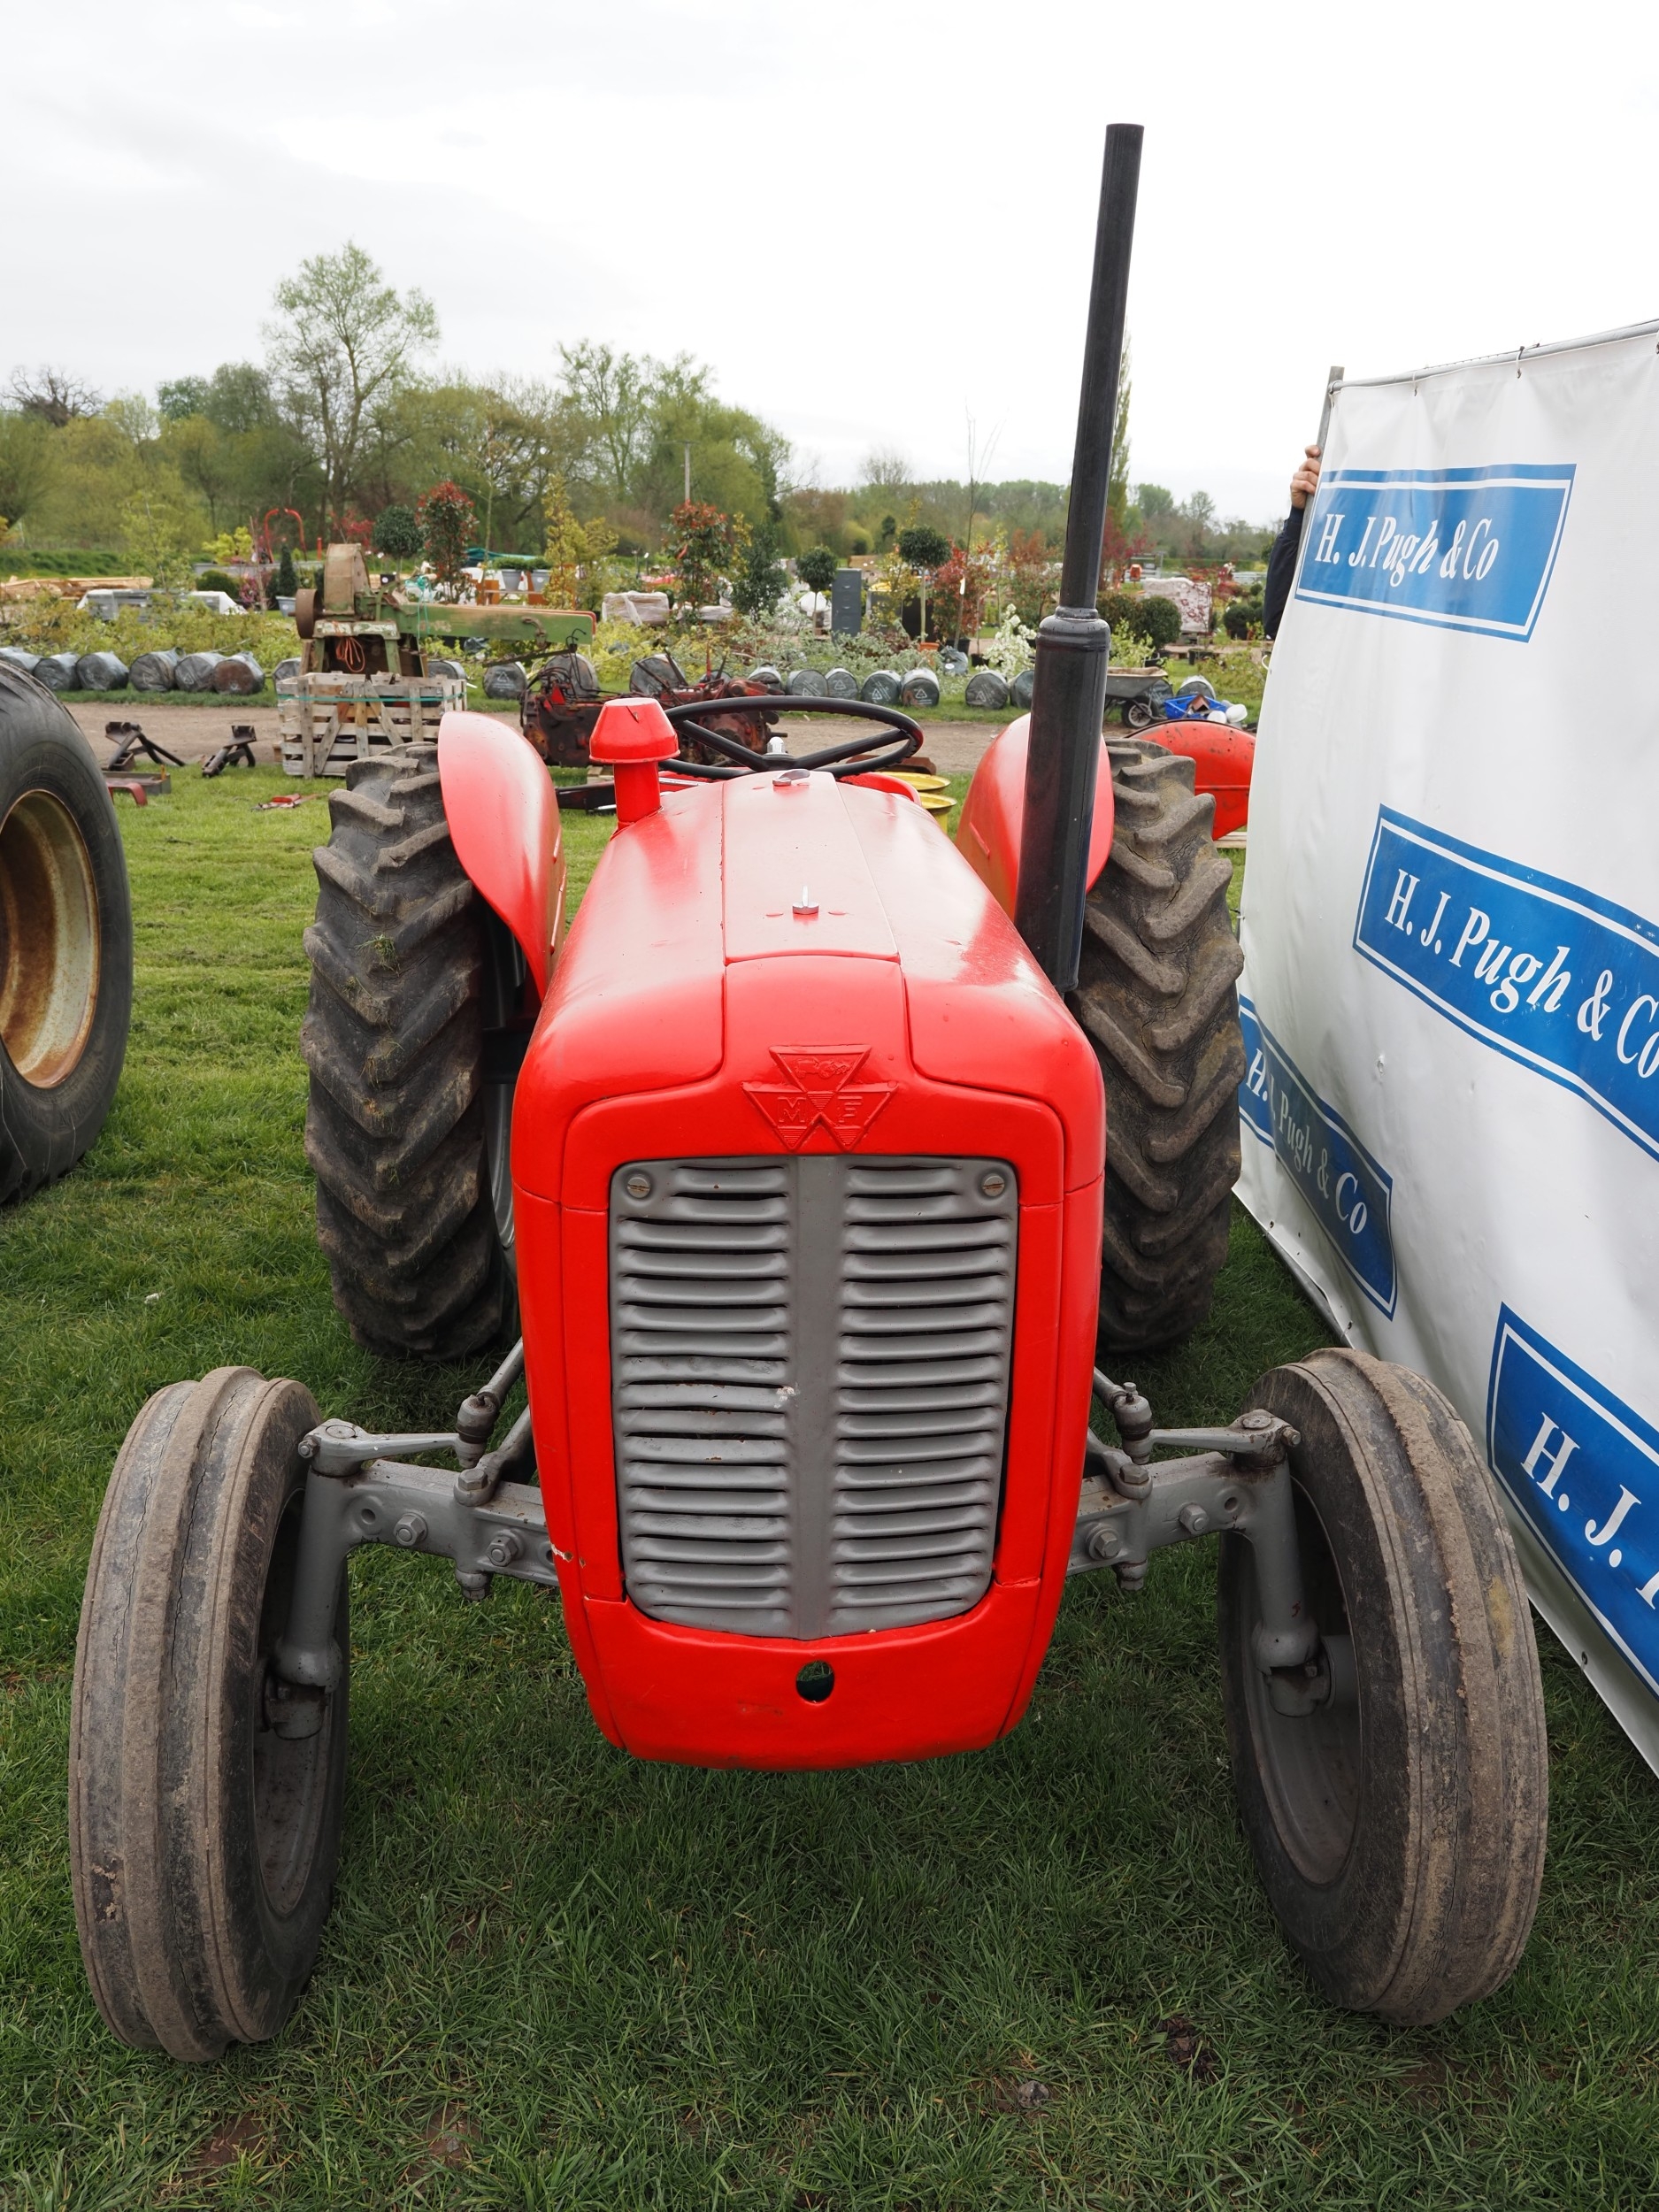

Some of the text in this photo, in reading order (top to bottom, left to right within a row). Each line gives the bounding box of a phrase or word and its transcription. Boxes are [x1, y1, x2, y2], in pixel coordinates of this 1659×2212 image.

[1315, 513, 1500, 588] H. J. Pugh & Co
[1385, 868, 1421, 935] H.
[1420, 890, 1452, 954] J.
[1448, 907, 1572, 1013] Pugh
[1577, 969, 1613, 1041] &
[1245, 1048, 1268, 1102] H.
[1279, 1090, 1313, 1174] Pugh
[1317, 1148, 1329, 1200] &
[1335, 1171, 1368, 1235] Co
[1520, 1412, 1642, 1568] H. J.
